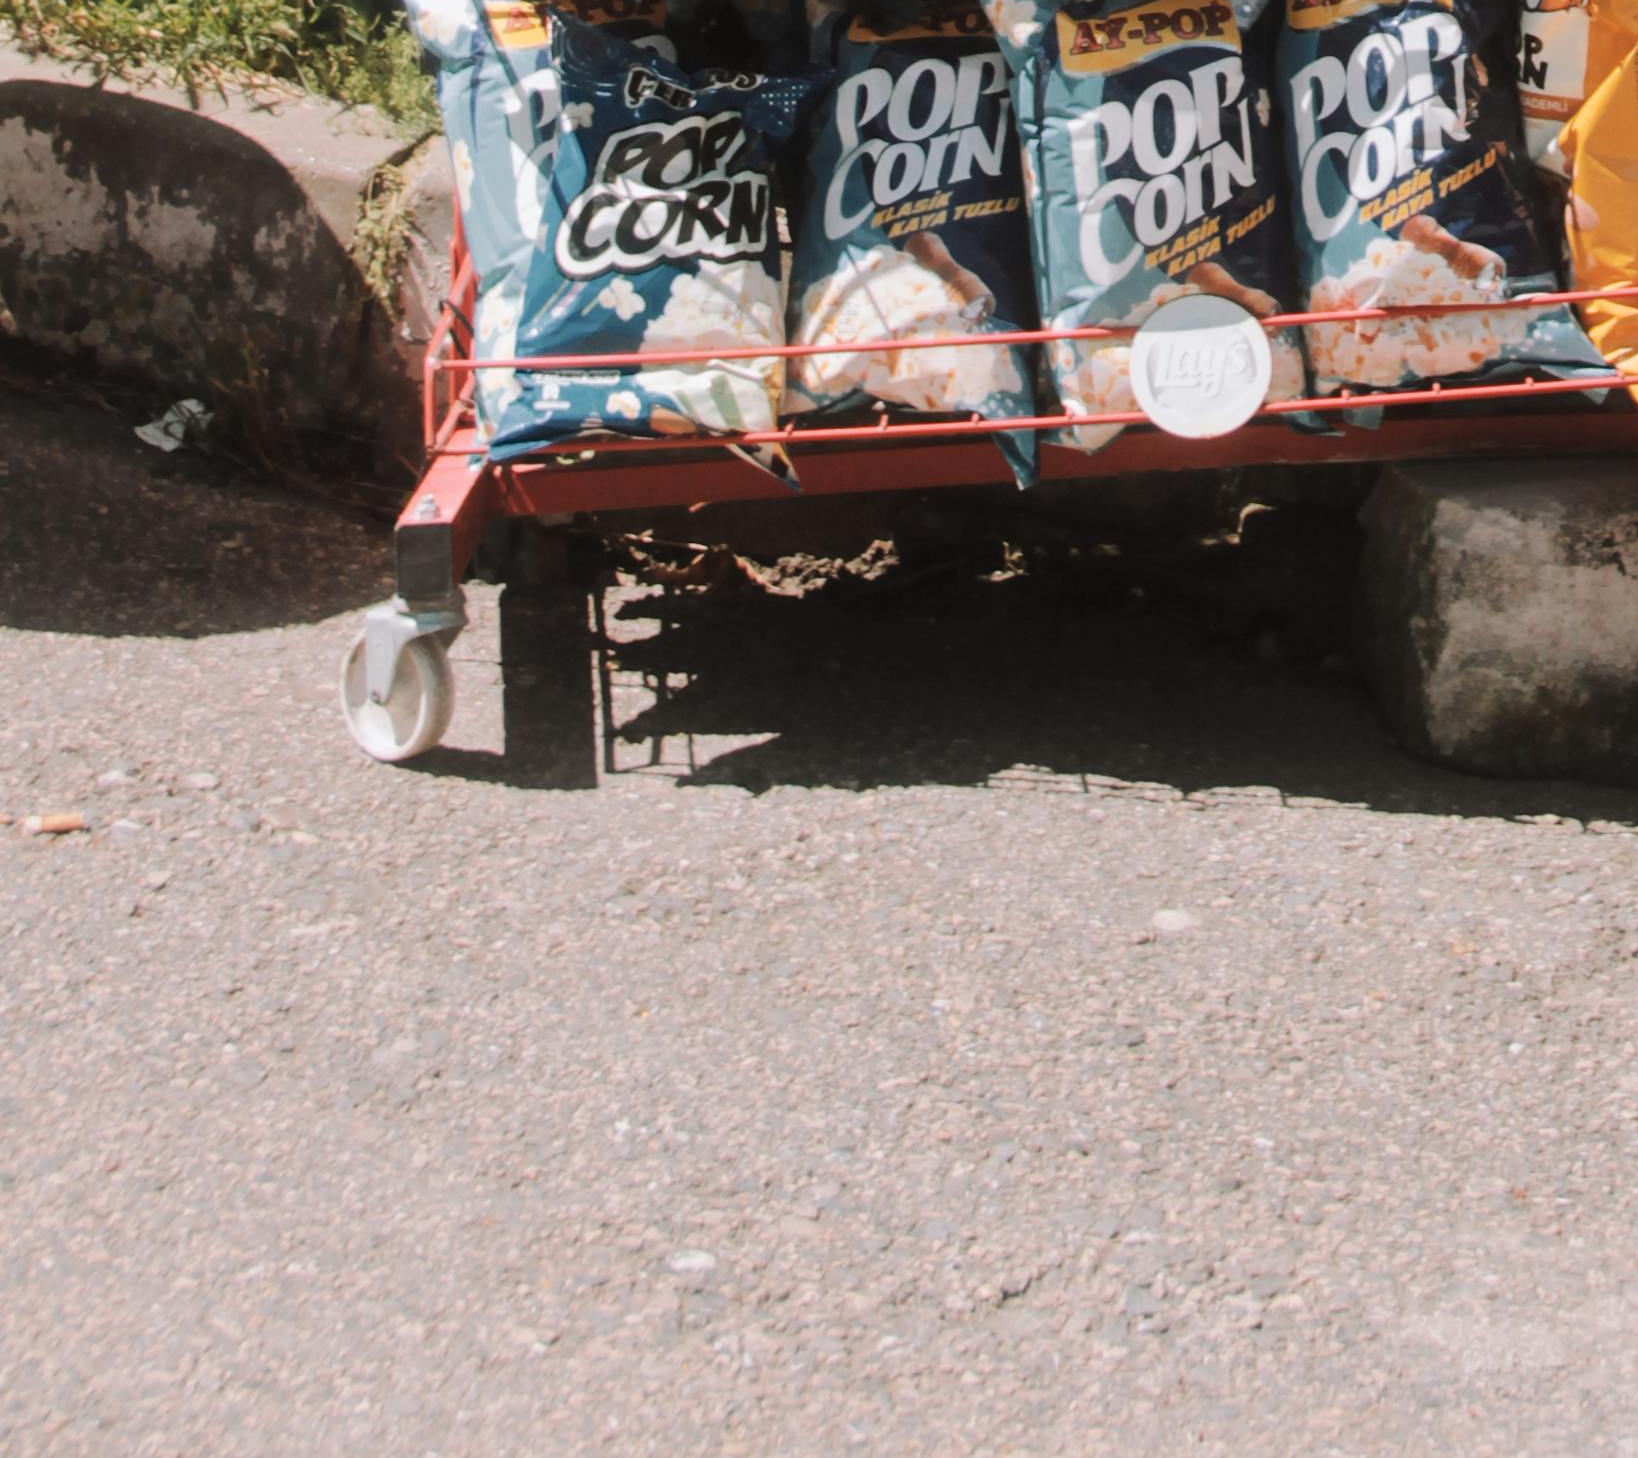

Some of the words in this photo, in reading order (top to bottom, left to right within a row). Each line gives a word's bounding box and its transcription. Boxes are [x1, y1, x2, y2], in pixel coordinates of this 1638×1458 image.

[836, 53, 1013, 155] POP
[1291, 12, 1463, 151] POP
[1067, 56, 1246, 216] POP
[563, 176, 768, 262] CORN
[888, 209, 947, 238] KAYA
[953, 197, 1020, 222] TUZLU
[1358, 167, 1433, 223] KLASİK
[1380, 189, 1436, 232] KAYA
[1437, 146, 1497, 207] TUZLU
[1145, 216, 1222, 272] KLASİK
[1167, 242, 1223, 277] KAYA
[1225, 195, 1276, 246] TUZLU
